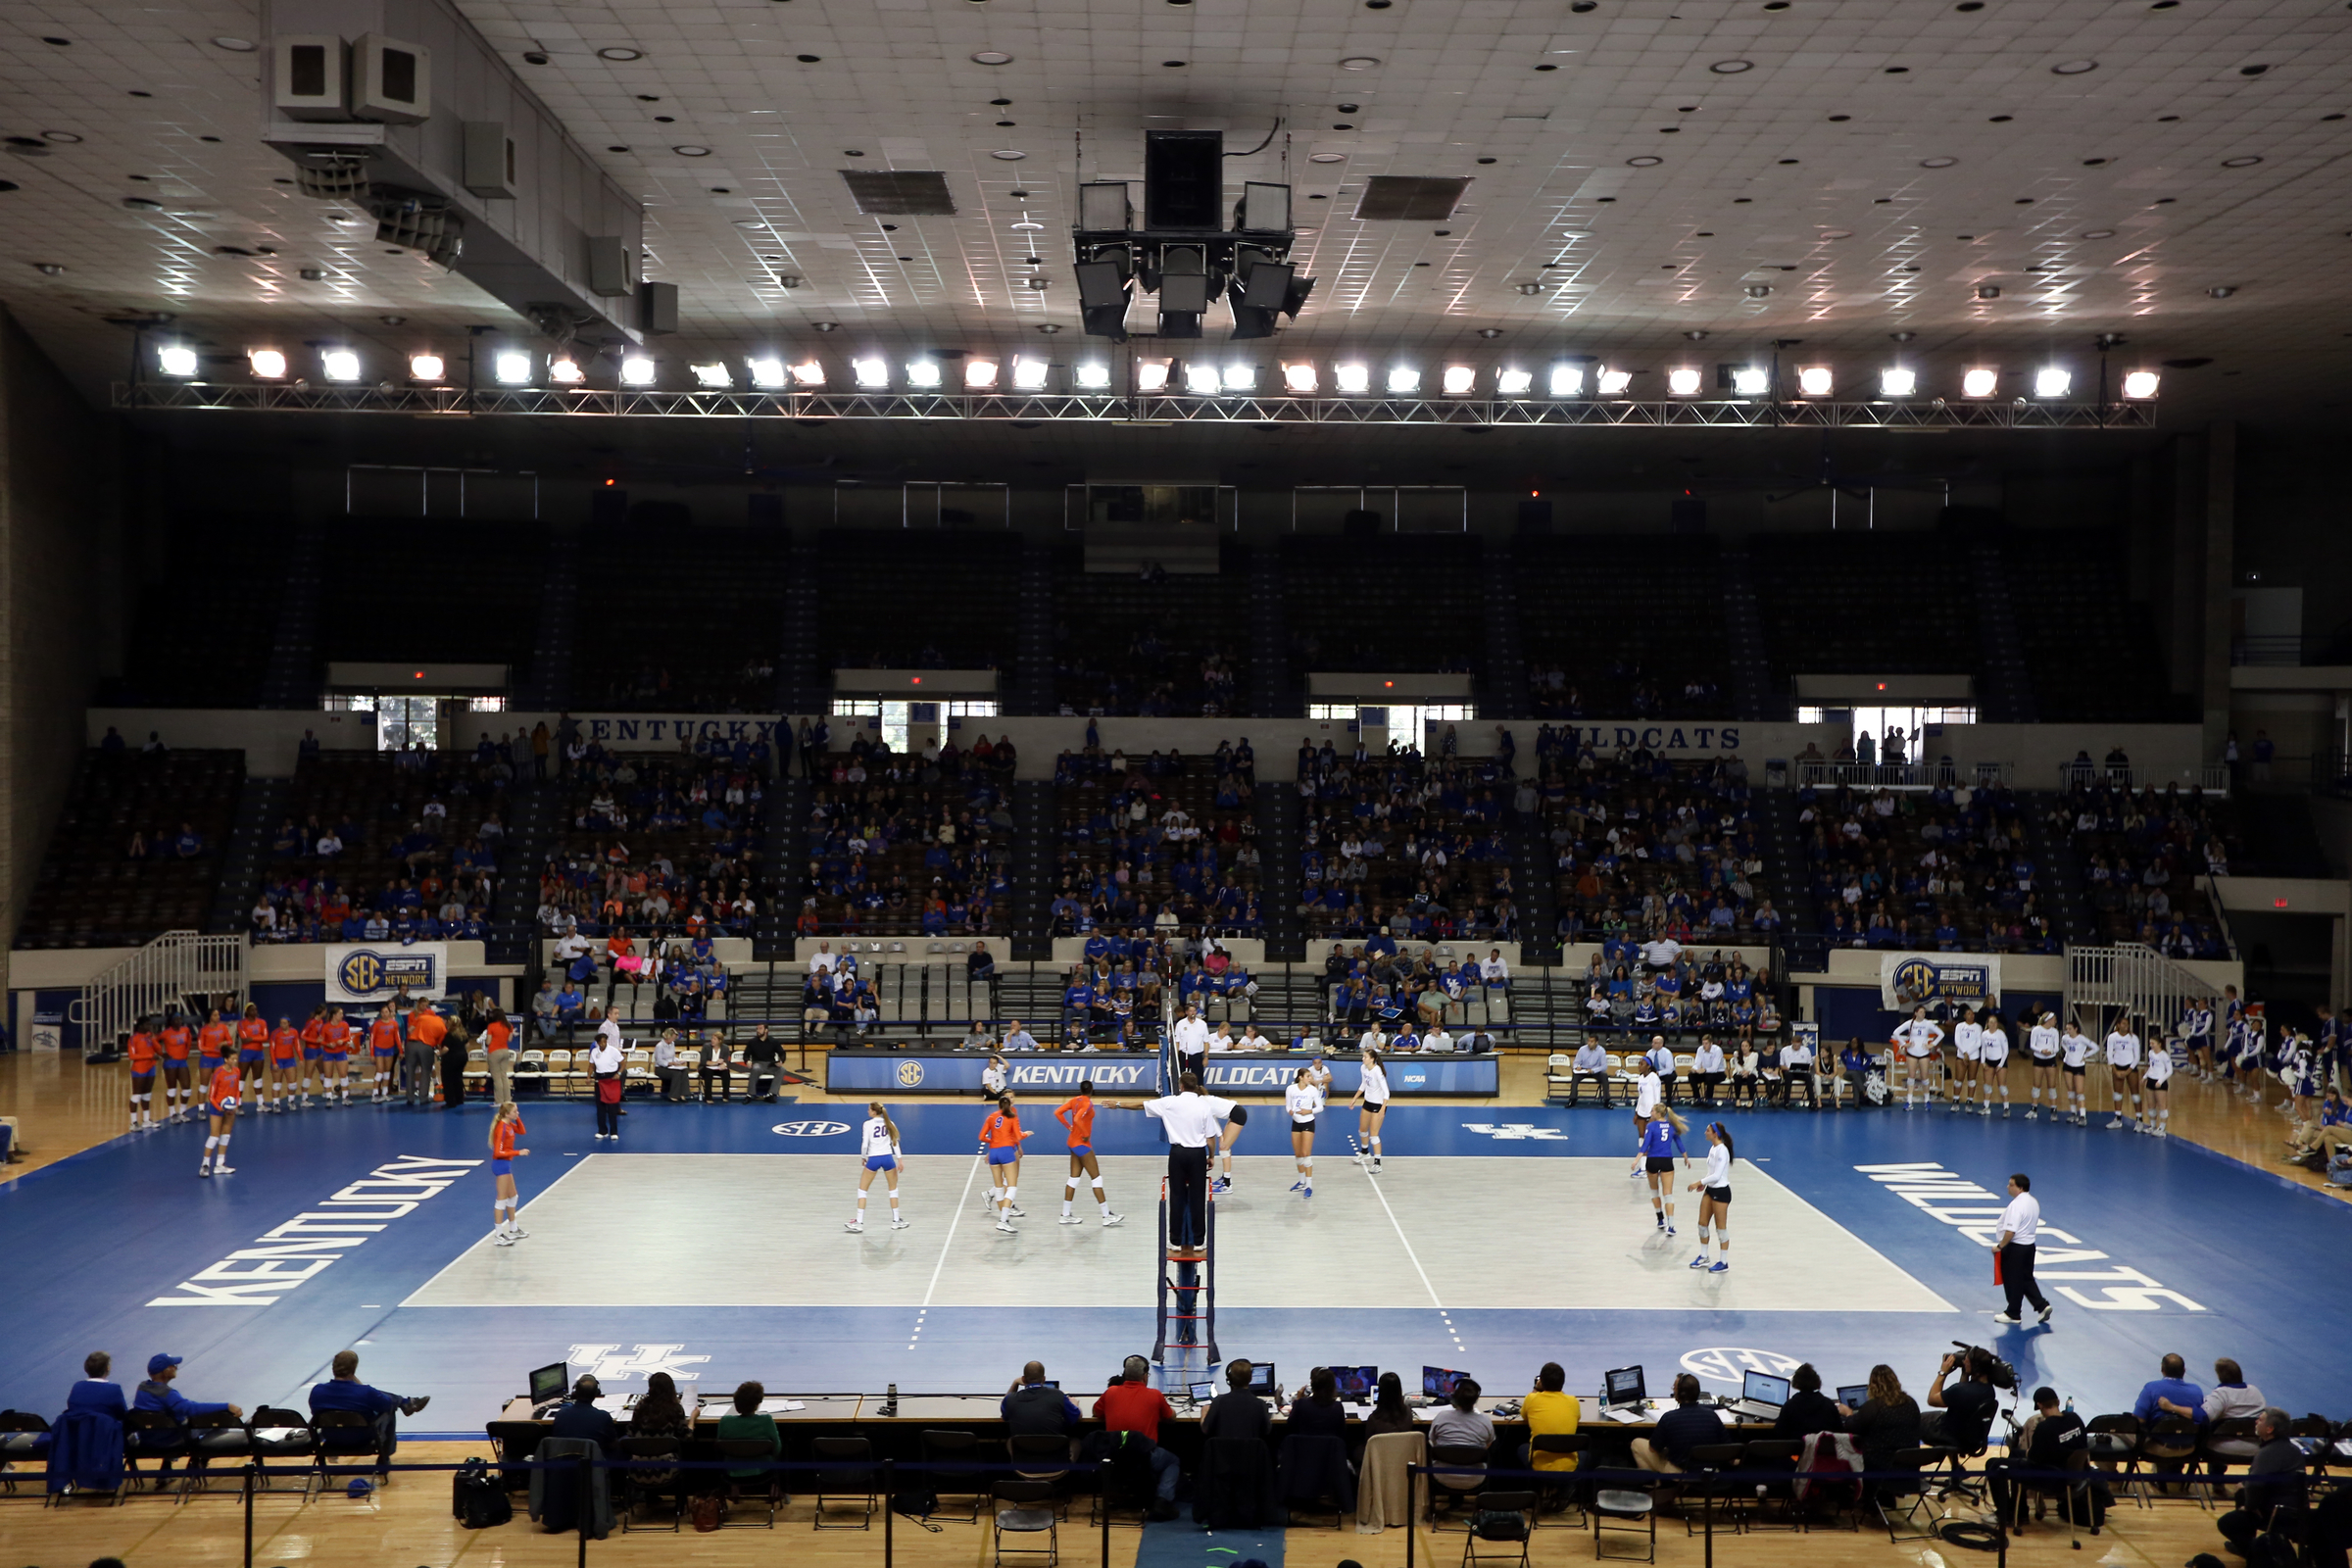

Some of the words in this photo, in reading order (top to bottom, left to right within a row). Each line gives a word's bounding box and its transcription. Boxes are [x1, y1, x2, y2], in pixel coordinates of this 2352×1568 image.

[385, 959, 427, 971] ESPN
[346, 956, 380, 990] SEC
[1938, 969, 1981, 981] ESPN
[385, 974, 426, 986] NETWORK
[1939, 985, 1981, 996] NETWORK
[900, 1062, 921, 1085] SEC
[1012, 1065, 1146, 1084] KENTUCKY
[1203, 1067, 1301, 1085] ILDCAT
[1402, 1074, 1425, 1084] NCAA
[776, 1122, 847, 1135] SEC
[995, 1116, 1004, 1128] 9
[873, 1125, 888, 1138] 20
[1660, 1128, 1669, 1142] 5
[145, 1154, 484, 1306] KENTUCKY
[2058, 1426, 2082, 1444] ESPN
